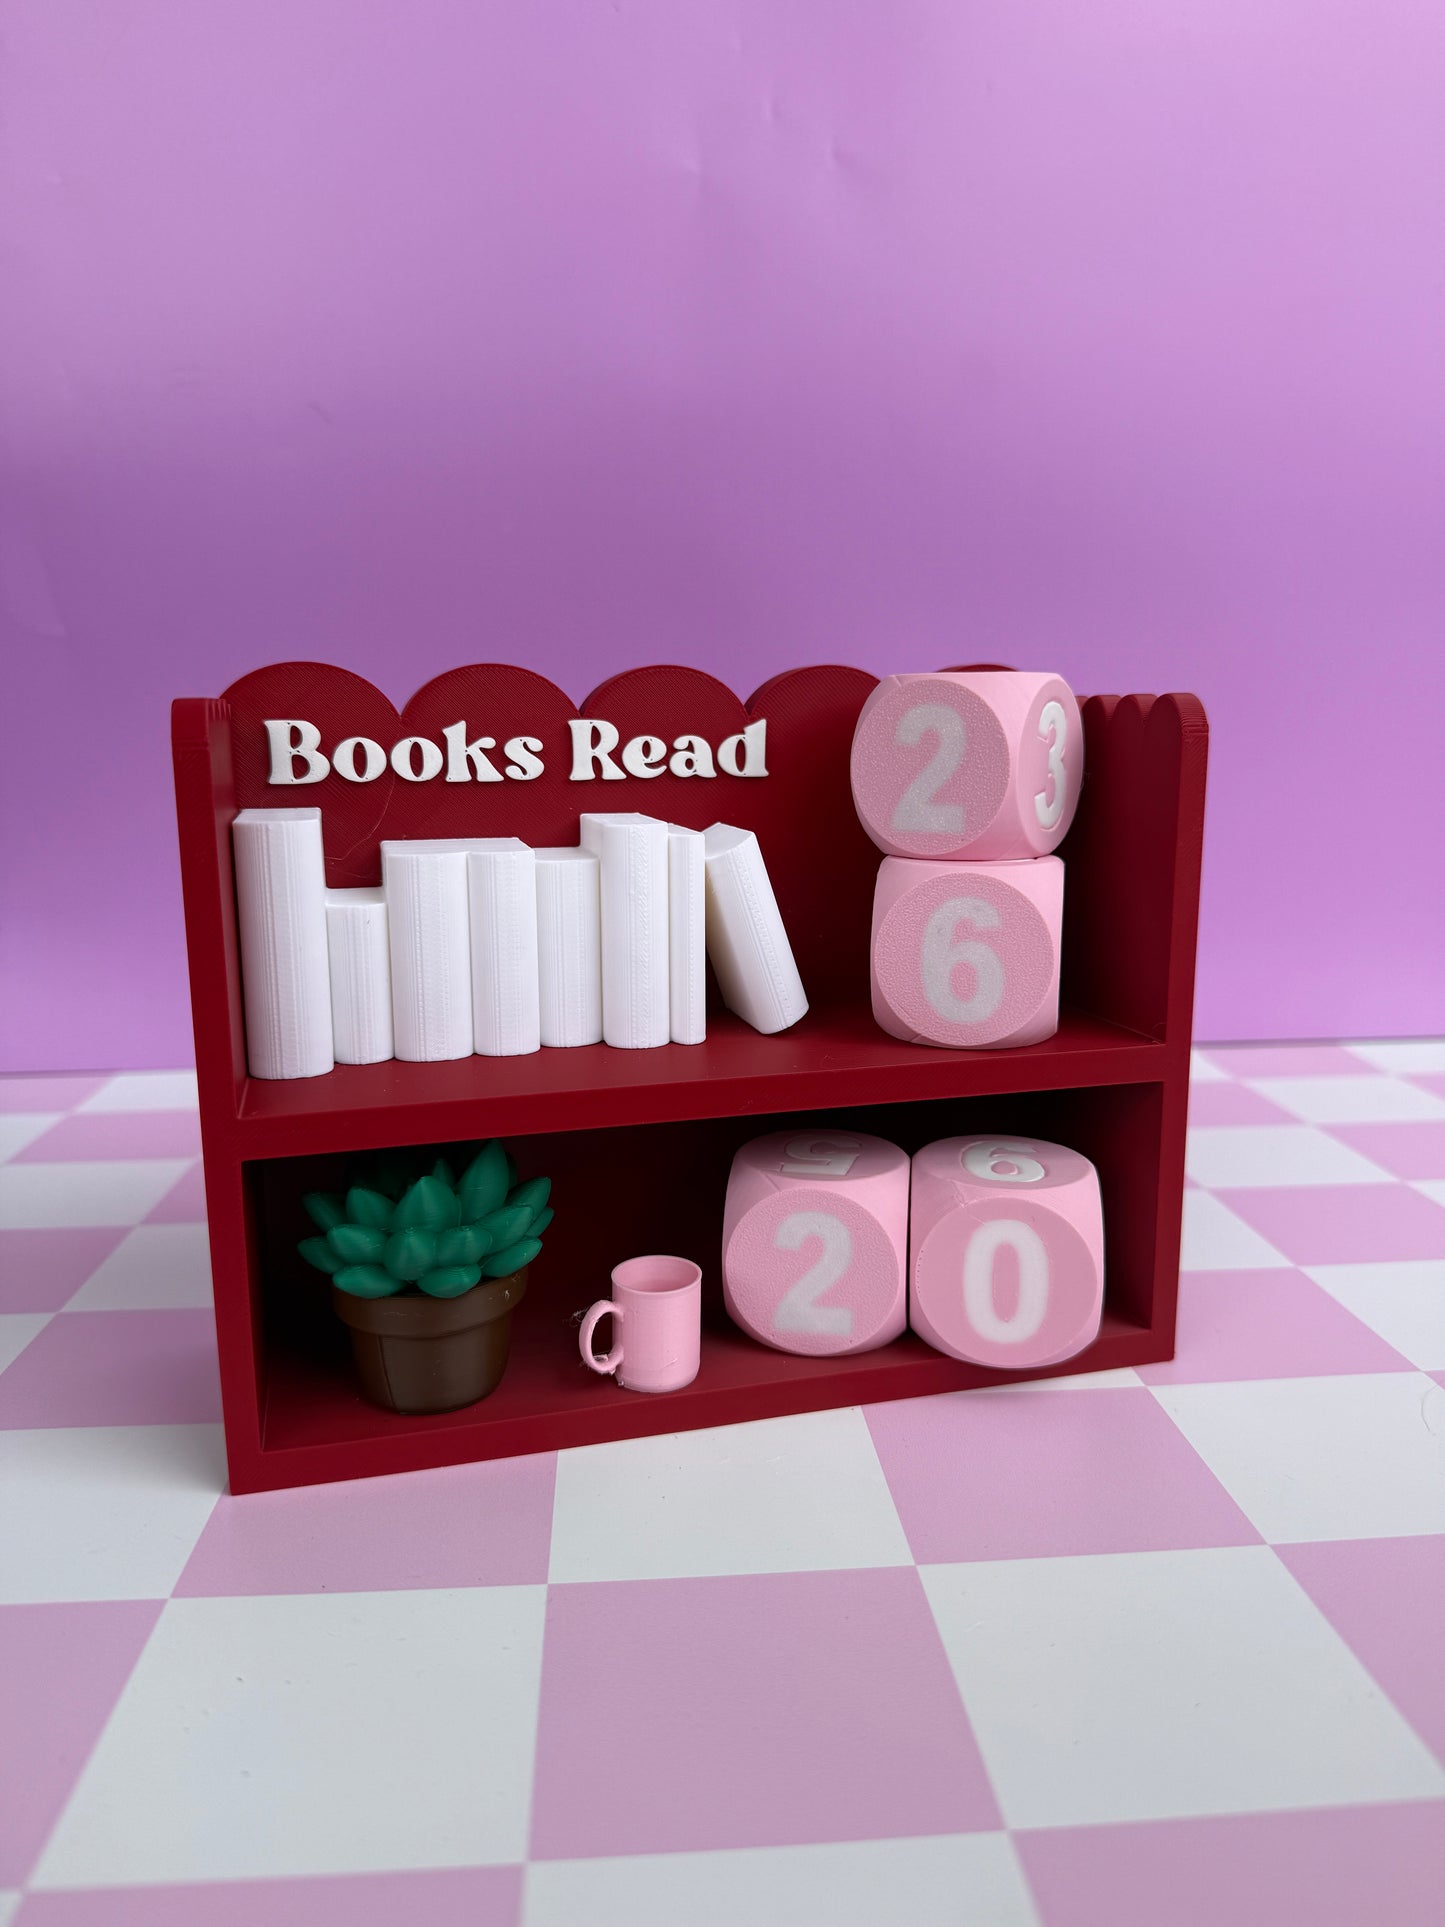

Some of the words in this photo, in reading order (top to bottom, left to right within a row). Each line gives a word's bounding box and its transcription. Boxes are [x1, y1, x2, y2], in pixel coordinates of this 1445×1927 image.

[264, 719, 545, 785] Books
[568, 718, 770, 781] Read
[891, 703, 967, 834] 2
[1034, 701, 1067, 830] 3
[922, 897, 1005, 1023] 6
[773, 1211, 854, 1336] 2
[963, 1219, 1049, 1343] 0
